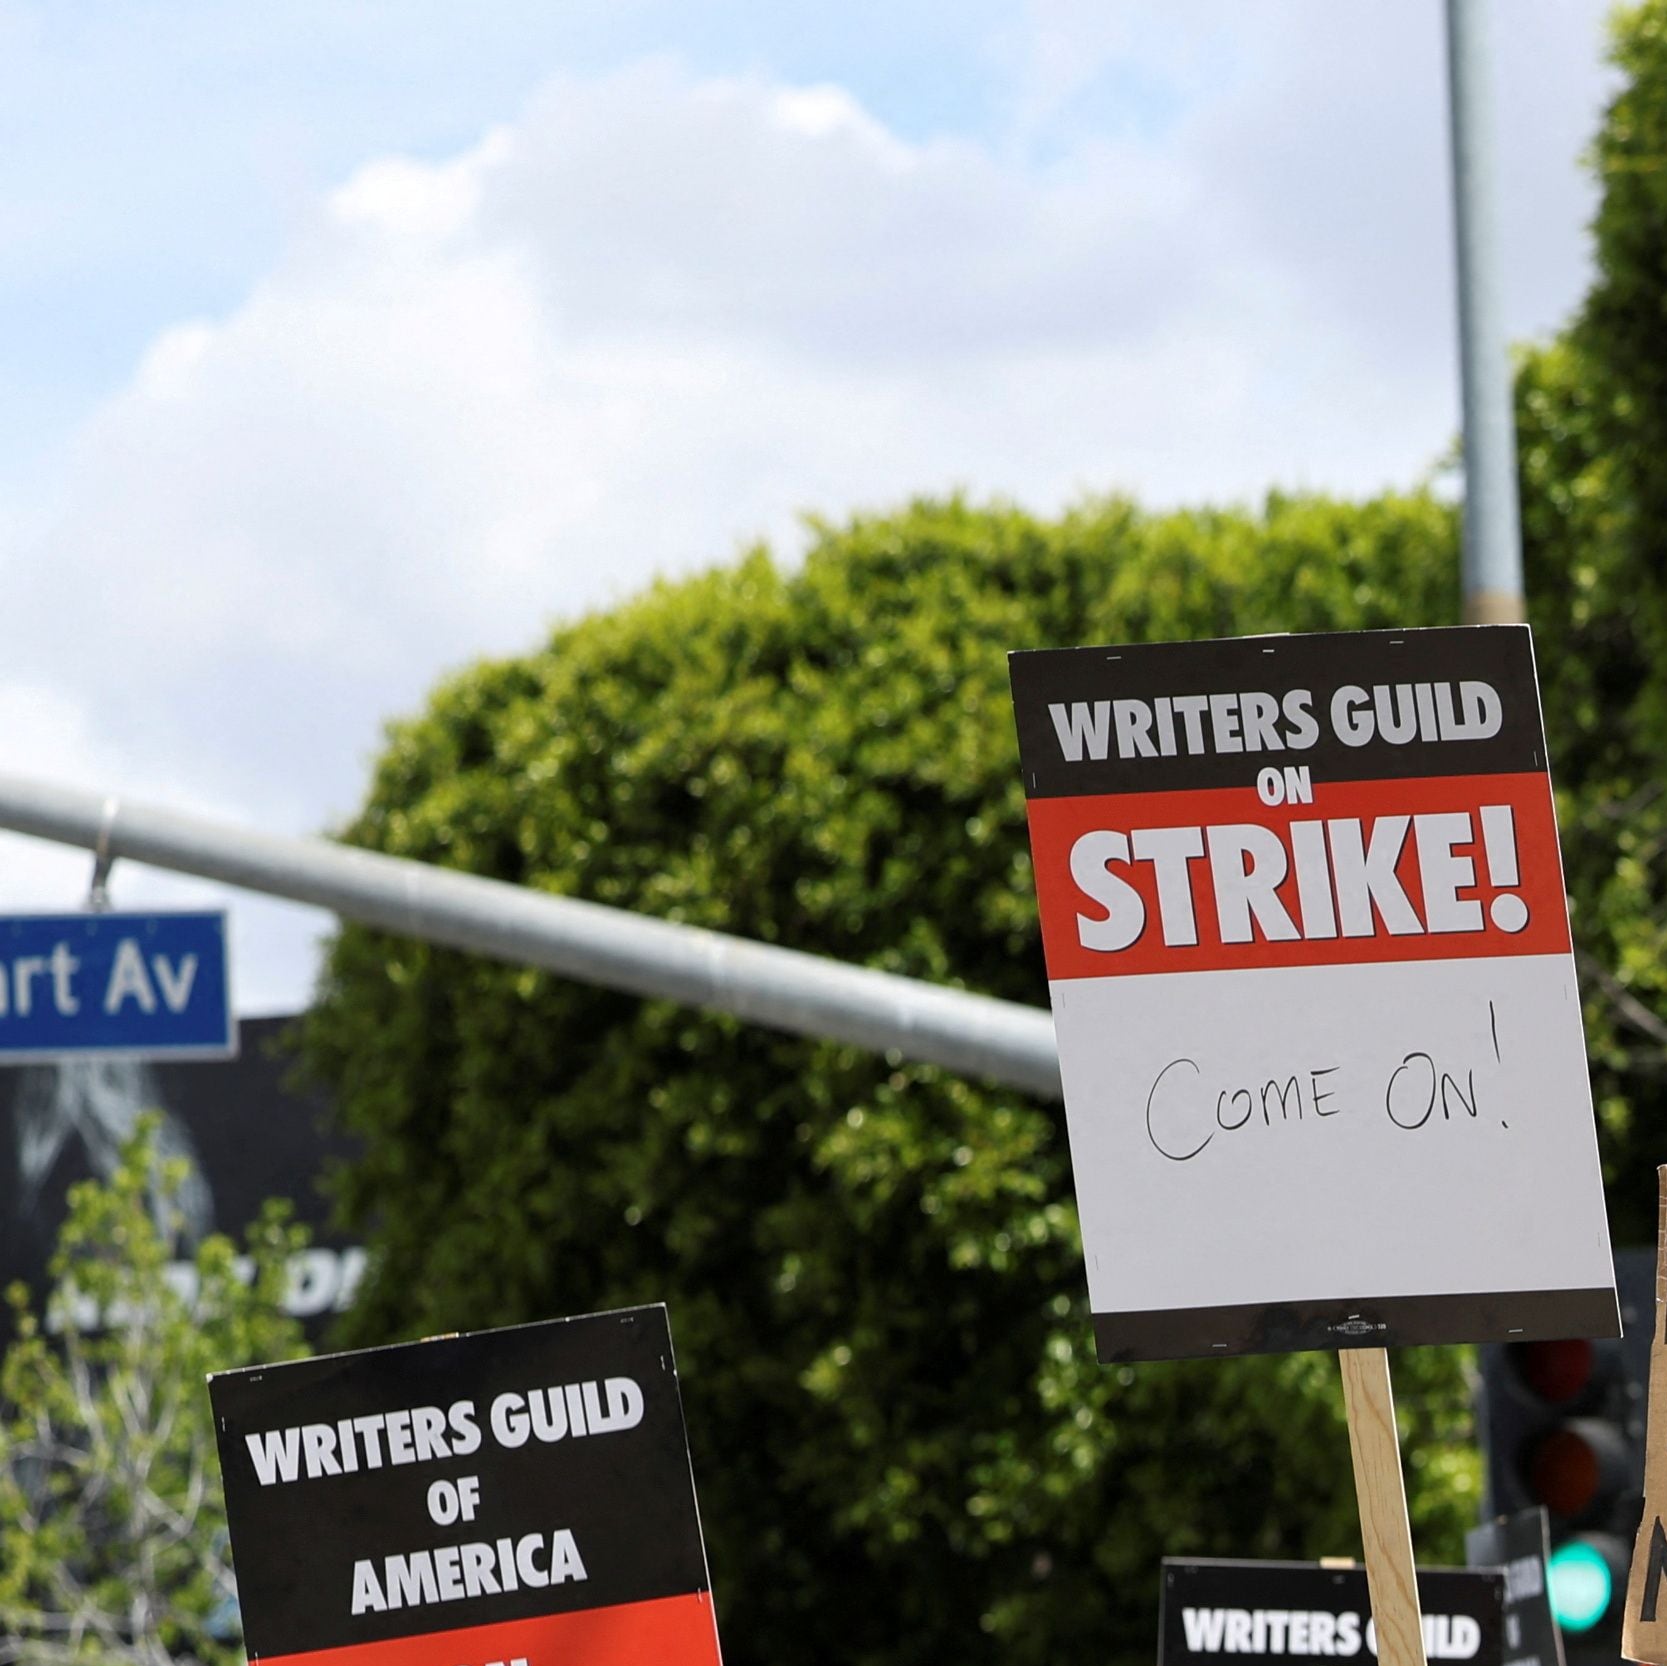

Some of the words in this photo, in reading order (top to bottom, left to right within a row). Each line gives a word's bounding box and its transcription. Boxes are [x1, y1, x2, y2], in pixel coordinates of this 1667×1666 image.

[1047, 689, 1321, 762] WRITERS
[1330, 680, 1503, 748] GUILD
[1256, 765, 1314, 806] ON
[1068, 804, 1531, 953] STRIKE!
[104, 938, 199, 1015] Av
[244, 1400, 482, 1487] WRITERS
[490, 1376, 644, 1449] GUILD
[427, 1475, 480, 1526] OF
[351, 1528, 588, 1615] AMERICA
[1182, 1607, 1362, 1657] WRITERS
